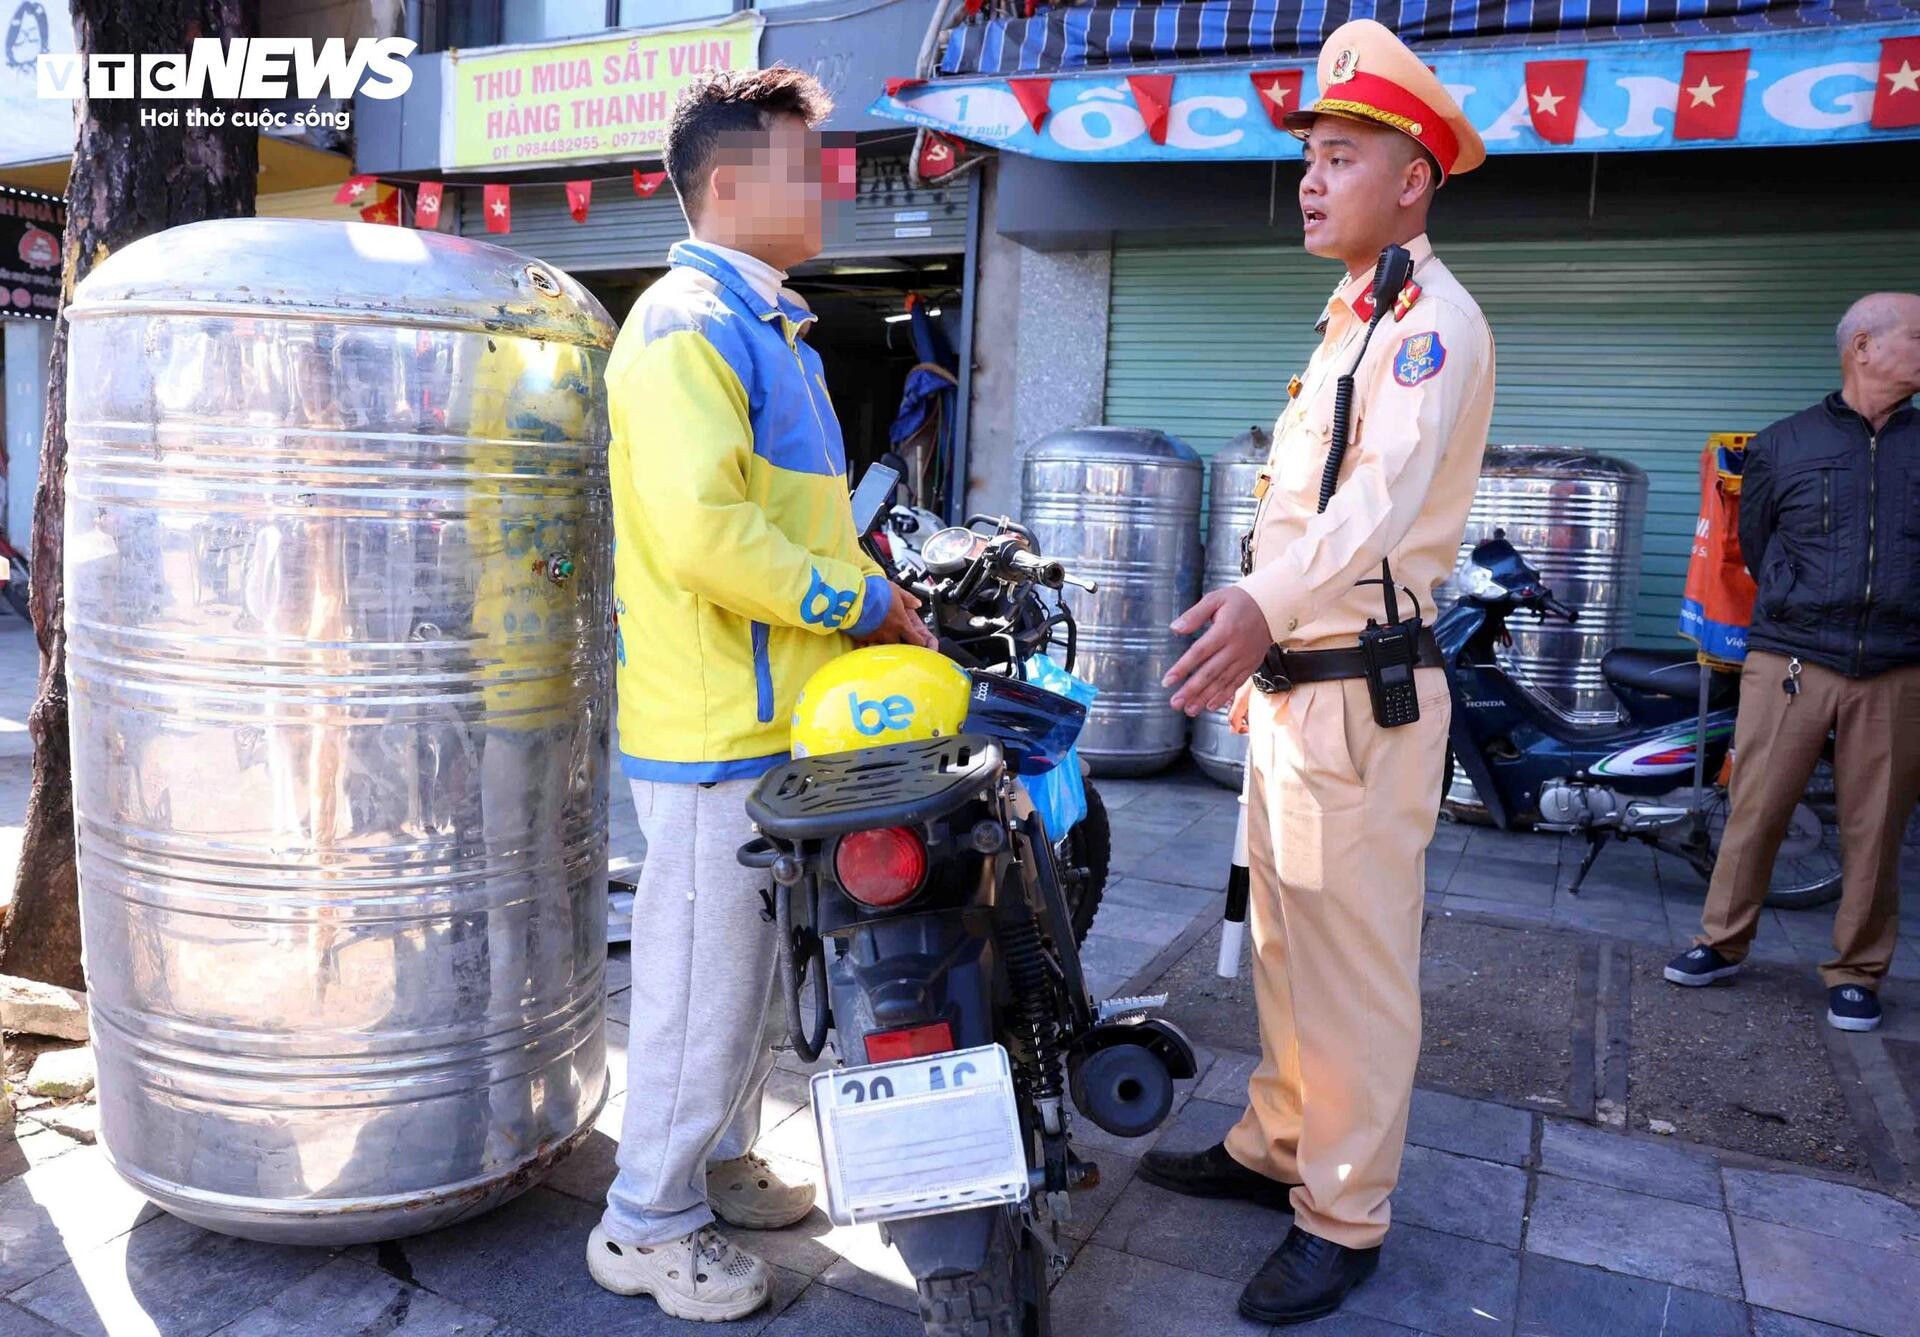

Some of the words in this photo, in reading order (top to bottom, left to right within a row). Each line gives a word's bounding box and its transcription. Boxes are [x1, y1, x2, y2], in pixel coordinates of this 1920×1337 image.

[473, 68, 521, 102] THU
[531, 59, 593, 95] MUA
[603, 41, 659, 85] SẮT
[571, 91, 667, 129] THANH
[955, 94, 969, 121] 1
[612, 129, 666, 148] 097293
[801, 562, 857, 628] be
[848, 692, 915, 736] be
[1466, 700, 1506, 708] HONDA
